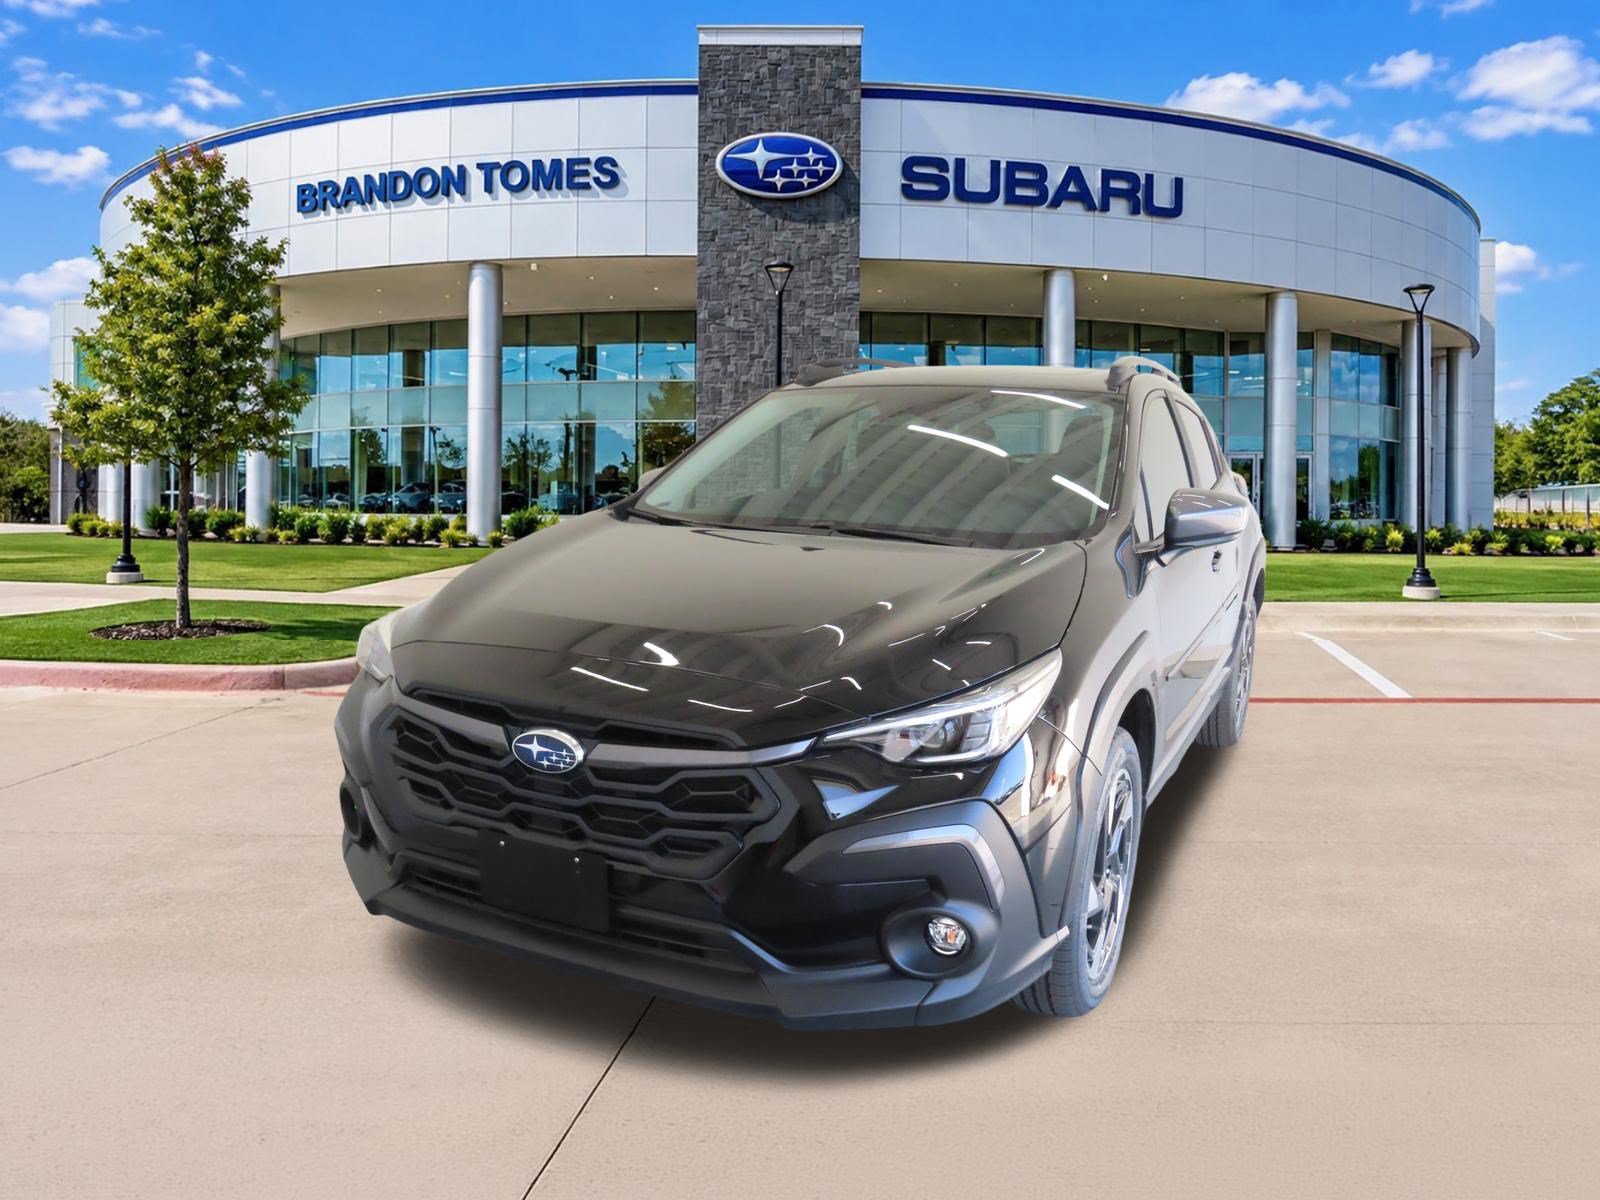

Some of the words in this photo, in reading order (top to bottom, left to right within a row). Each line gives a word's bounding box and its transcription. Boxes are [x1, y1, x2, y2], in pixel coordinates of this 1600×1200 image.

[296, 164, 466, 213] BRANDON
[476, 156, 620, 193] TOMES
[901, 155, 1184, 218] SUBARU
